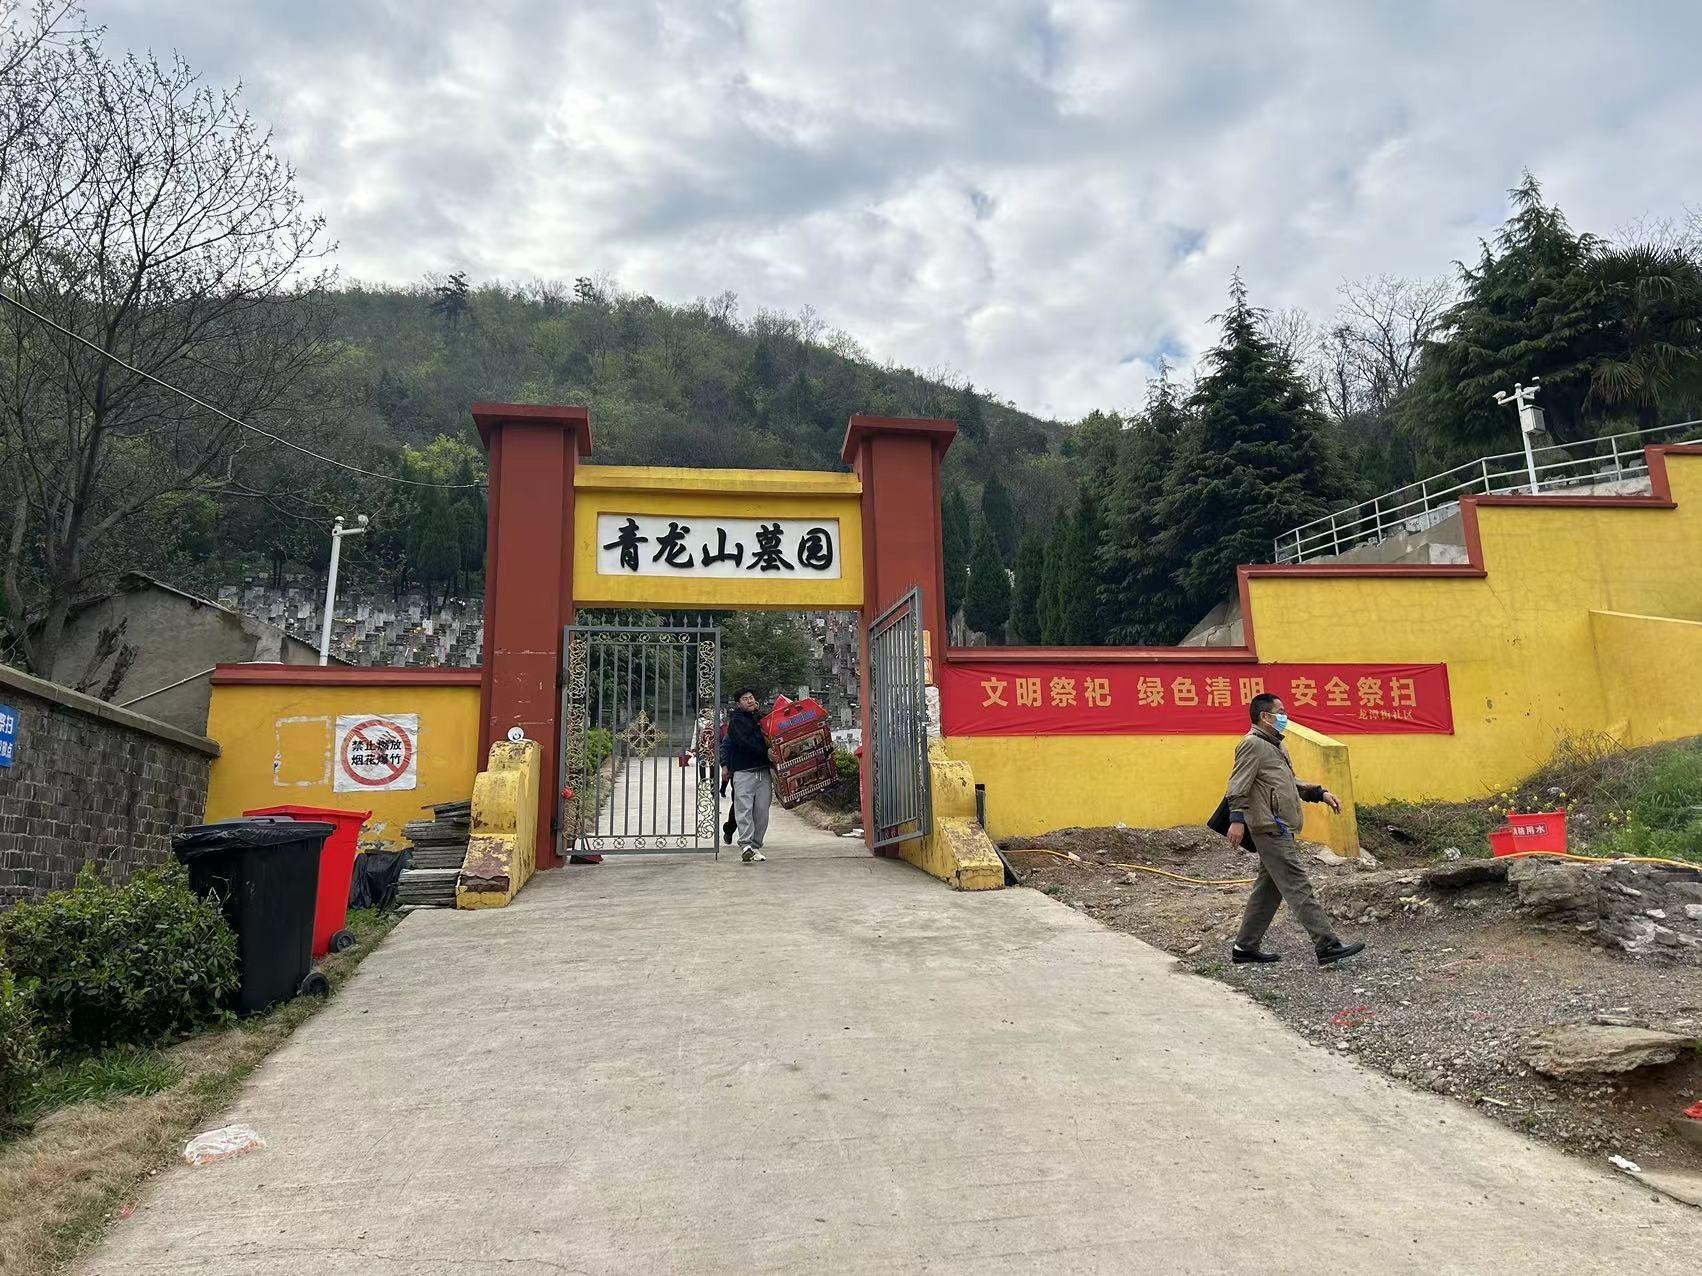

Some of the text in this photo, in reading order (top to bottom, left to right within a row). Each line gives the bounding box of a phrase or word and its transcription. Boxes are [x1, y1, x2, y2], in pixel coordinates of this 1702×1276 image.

[603, 517, 833, 572] 青龙山墓园
[980, 676, 1417, 708] 文明祭祀 绿色清明 安全祭扫
[351, 739, 402, 752] 禁止燃放
[351, 753, 402, 766] 烟花爆竹
